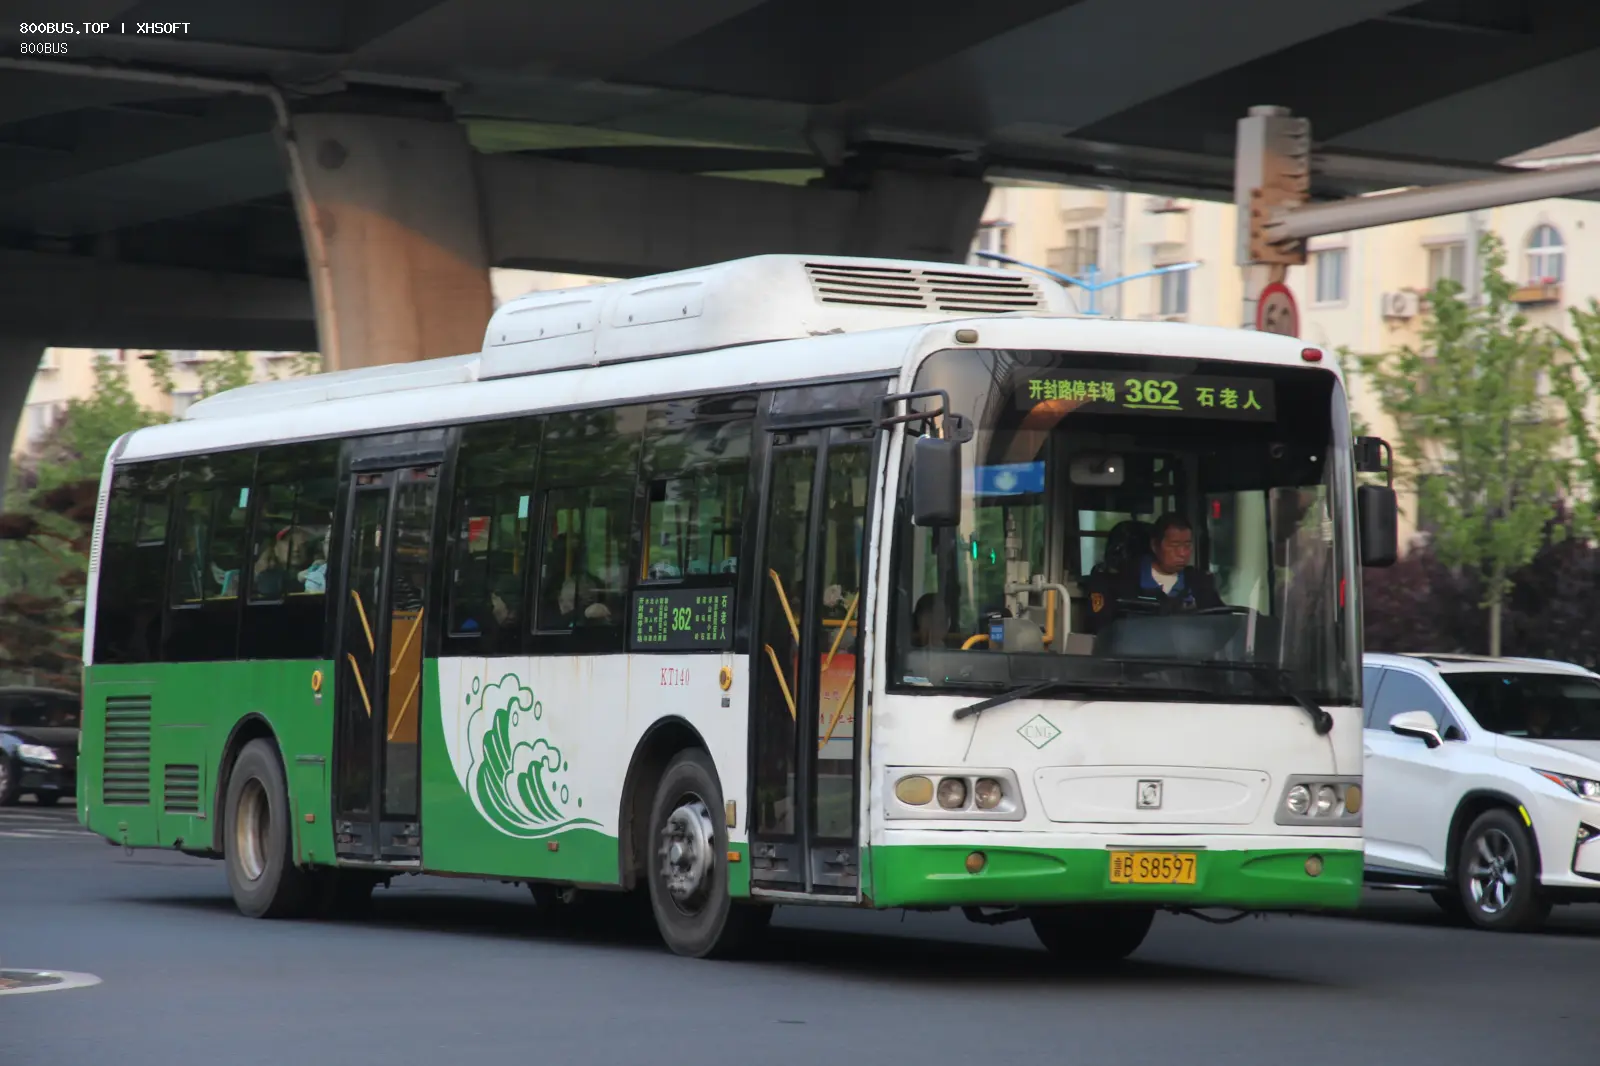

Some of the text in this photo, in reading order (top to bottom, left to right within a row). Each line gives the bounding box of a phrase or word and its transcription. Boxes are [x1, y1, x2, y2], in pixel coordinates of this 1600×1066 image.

[1028, 378, 1262, 410] 开封路停车场 362 石老人
[671, 607, 692, 631] 362
[660, 667, 690, 686] KT140
[1025, 725, 1052, 739] CNG
[1139, 856, 1195, 879] S8597
